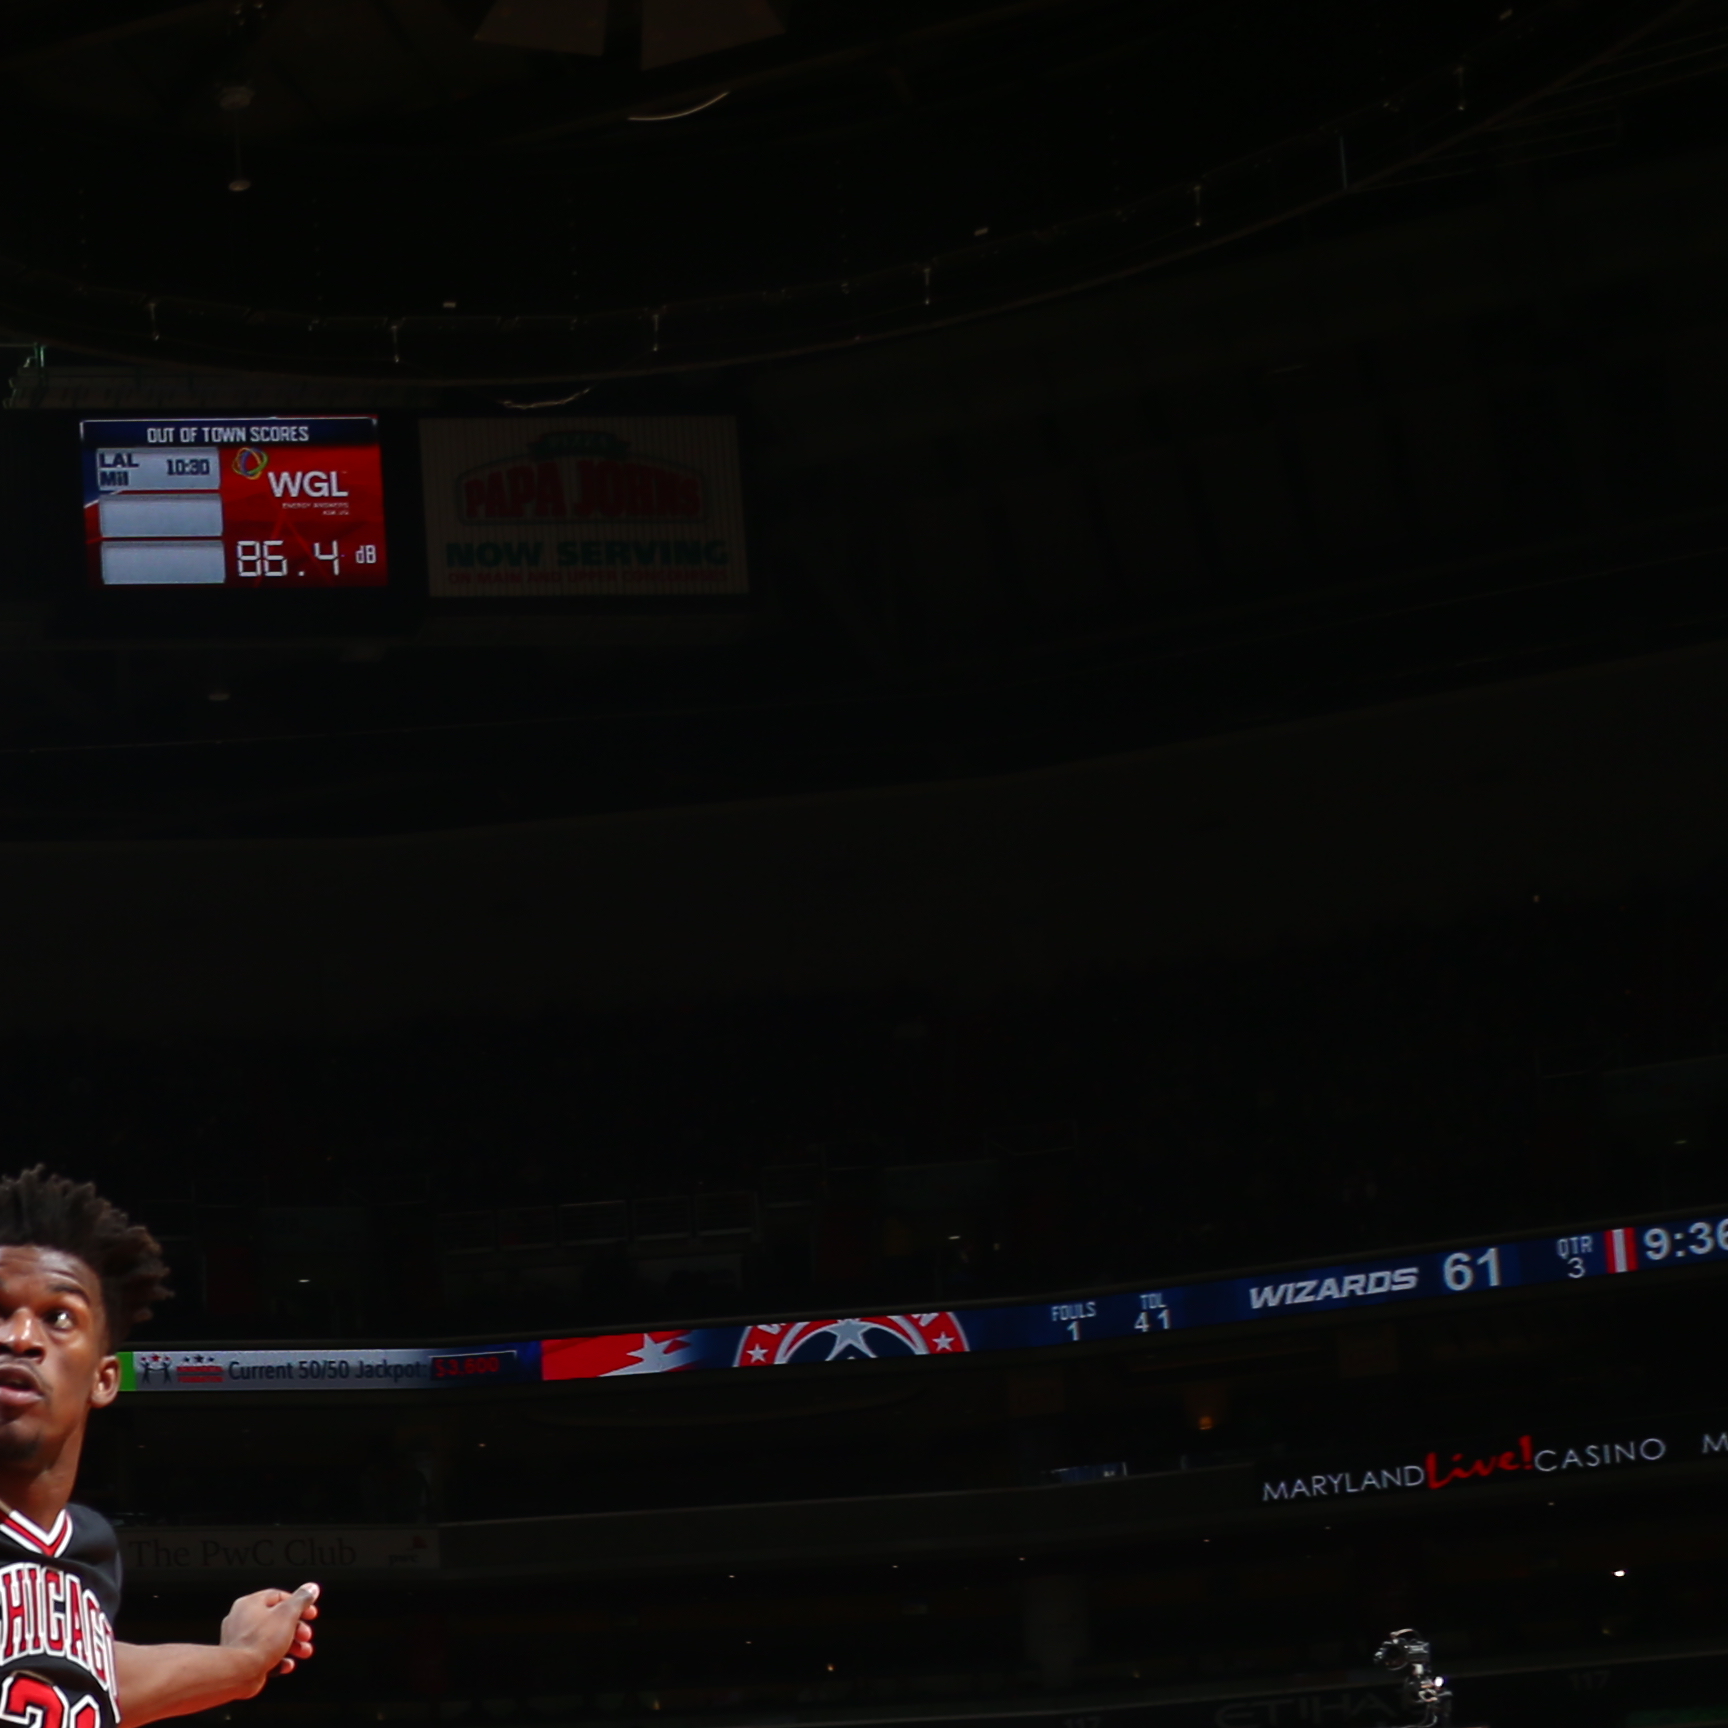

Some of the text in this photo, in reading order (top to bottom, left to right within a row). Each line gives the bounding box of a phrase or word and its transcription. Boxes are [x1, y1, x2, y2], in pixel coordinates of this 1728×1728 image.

[147, 426, 309, 443] OUT OF TOWN SCORES
[99, 452, 211, 476] LAL 10:30
[268, 471, 349, 497] WGL
[464, 460, 568, 518] PAPA
[355, 544, 377, 564] dB
[446, 540, 729, 568] NOW SERVING
[1249, 1266, 1420, 1310] WIZARDS
[1443, 1247, 1502, 1293] 61
[1555, 1236, 1594, 1259] QTR
[1566, 1257, 1587, 1280] 3
[1051, 1301, 1097, 1321] FOULS
[1067, 1309, 1171, 1341] 1 4 1
[228, 1359, 294, 1381] Current
[298, 1358, 350, 1381] 50/50
[1262, 1435, 1667, 1502] MARYLAND Live! CASINO
[129, 1540, 190, 1567] The
[200, 1539, 275, 1567] PwC
[284, 1538, 357, 1567] Club
